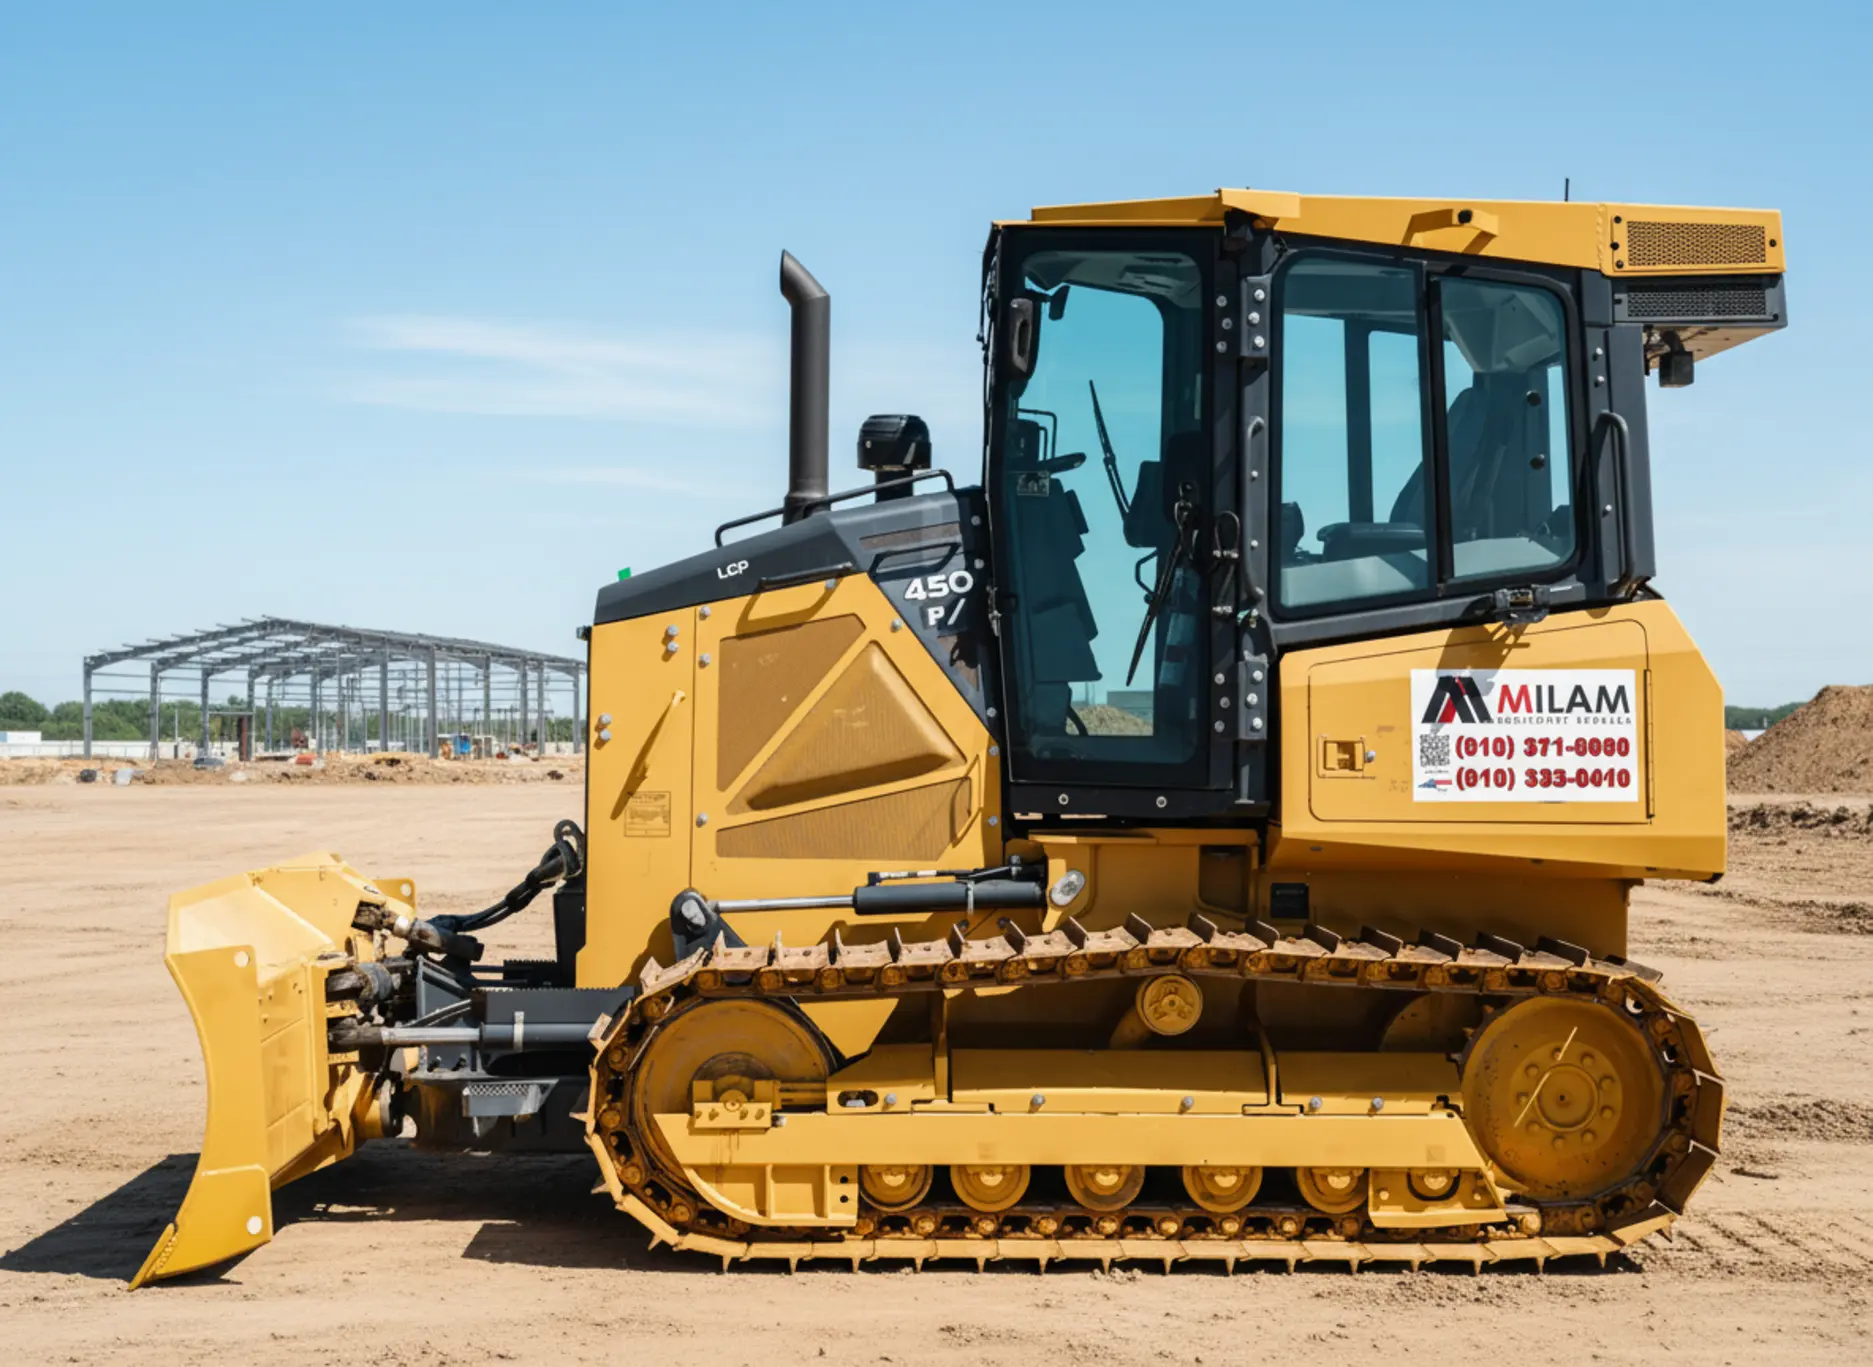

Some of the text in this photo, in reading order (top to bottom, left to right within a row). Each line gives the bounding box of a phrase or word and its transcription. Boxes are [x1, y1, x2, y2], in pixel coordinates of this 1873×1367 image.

[716, 560, 750, 580] LCP
[904, 570, 974, 601] 450
[1497, 685, 1630, 713] MILAM
